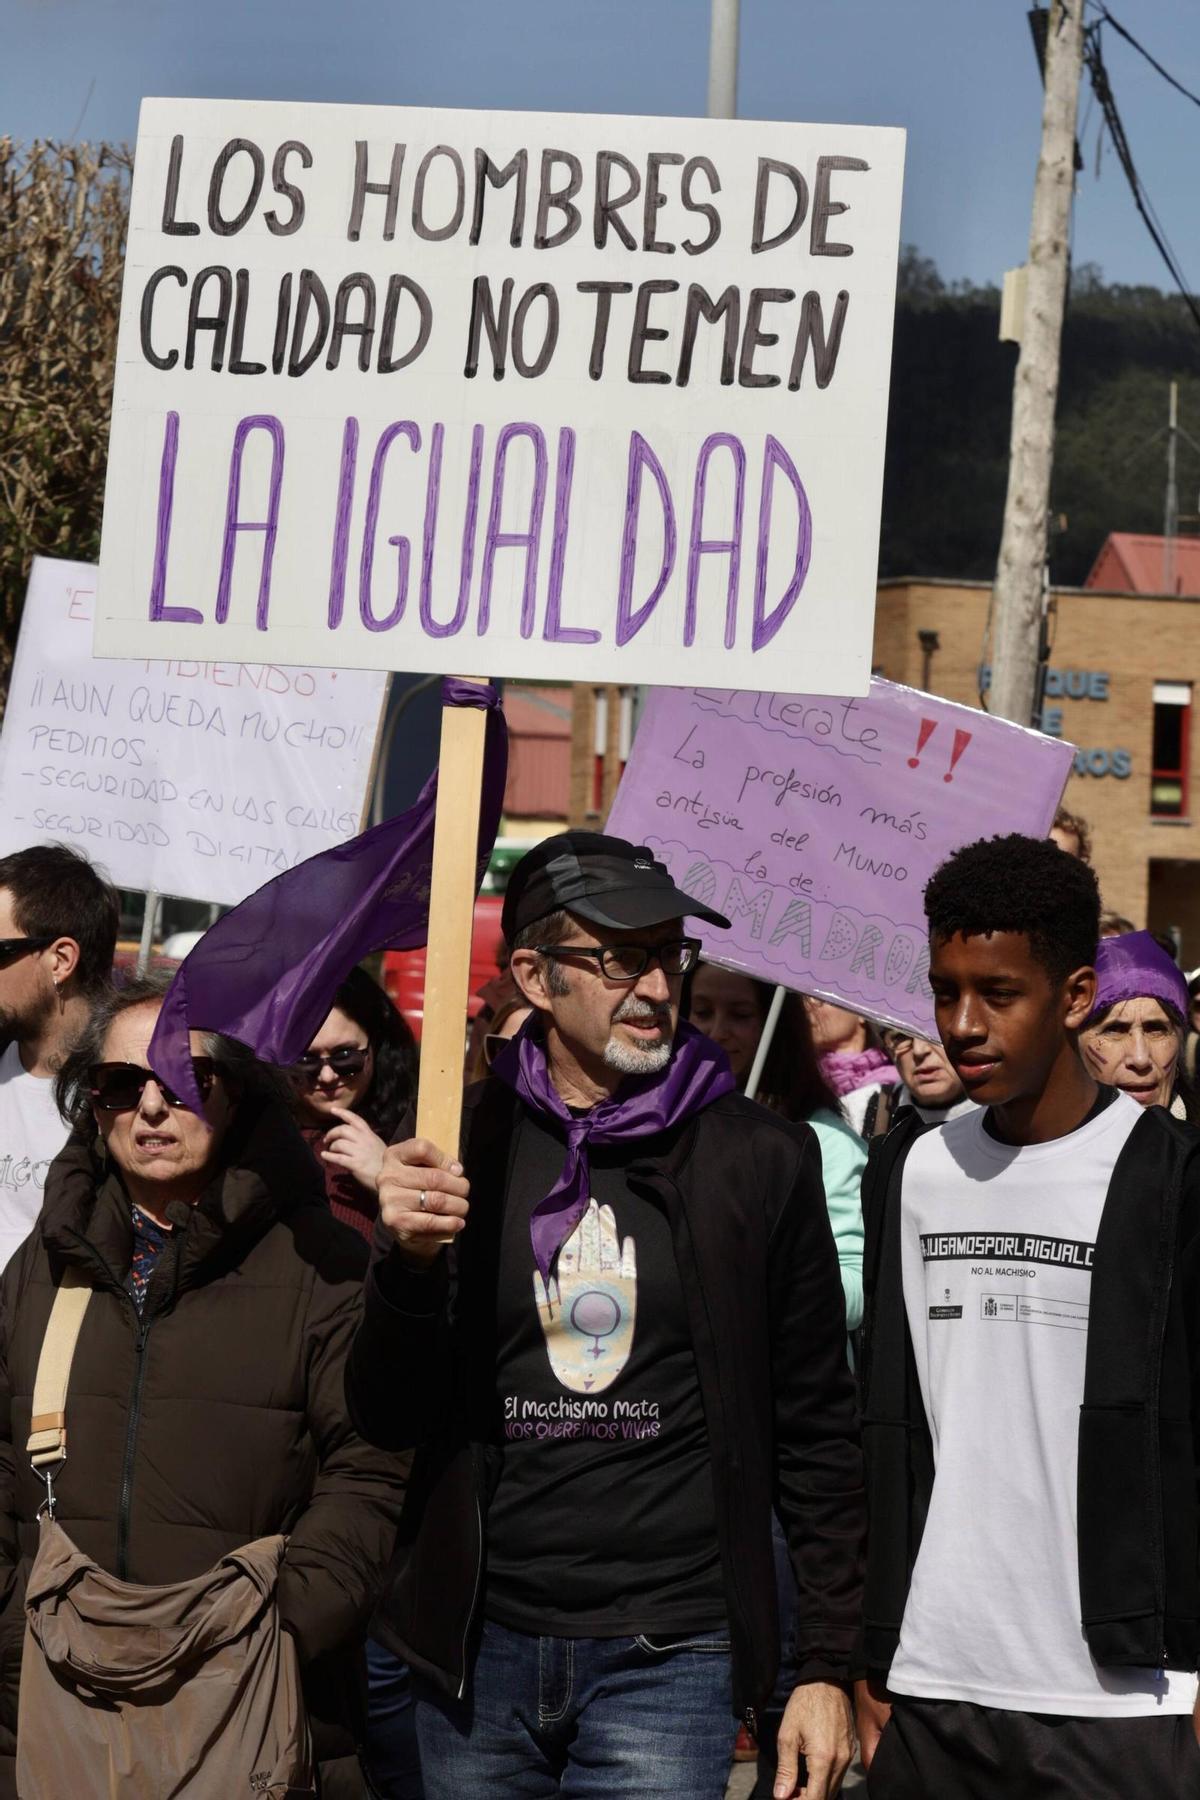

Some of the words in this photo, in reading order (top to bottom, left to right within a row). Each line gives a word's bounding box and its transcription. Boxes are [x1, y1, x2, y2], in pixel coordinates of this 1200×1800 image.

[162, 134, 314, 237] LOS
[347, 141, 721, 256] HOMBRES
[751, 155, 872, 257] DE
[140, 265, 433, 378] CALIDAD
[464, 275, 560, 382] NO
[576, 279, 850, 392] TEMEN
[149, 411, 286, 632] LA
[327, 416, 813, 654] IGUALDAD
[129, 686, 226, 737] QUEDA
[673, 724, 705, 769] La
[737, 766, 842, 807] profesión
[860, 807, 927, 840] más
[188, 788, 224, 812] EN
[232, 796, 277, 825] LAS
[285, 806, 359, 838] CALLES
[770, 828, 810, 852] del
[833, 842, 908, 881] MUNDO
[971, 1267, 984, 1276] NO
[985, 1267, 994, 1276] AL
[995, 1267, 1036, 1279] MACHISMO
[504, 1396, 518, 1420] El
[535, 1420, 619, 1440] QUEREMOS
[621, 1420, 661, 1440] VIVAS
